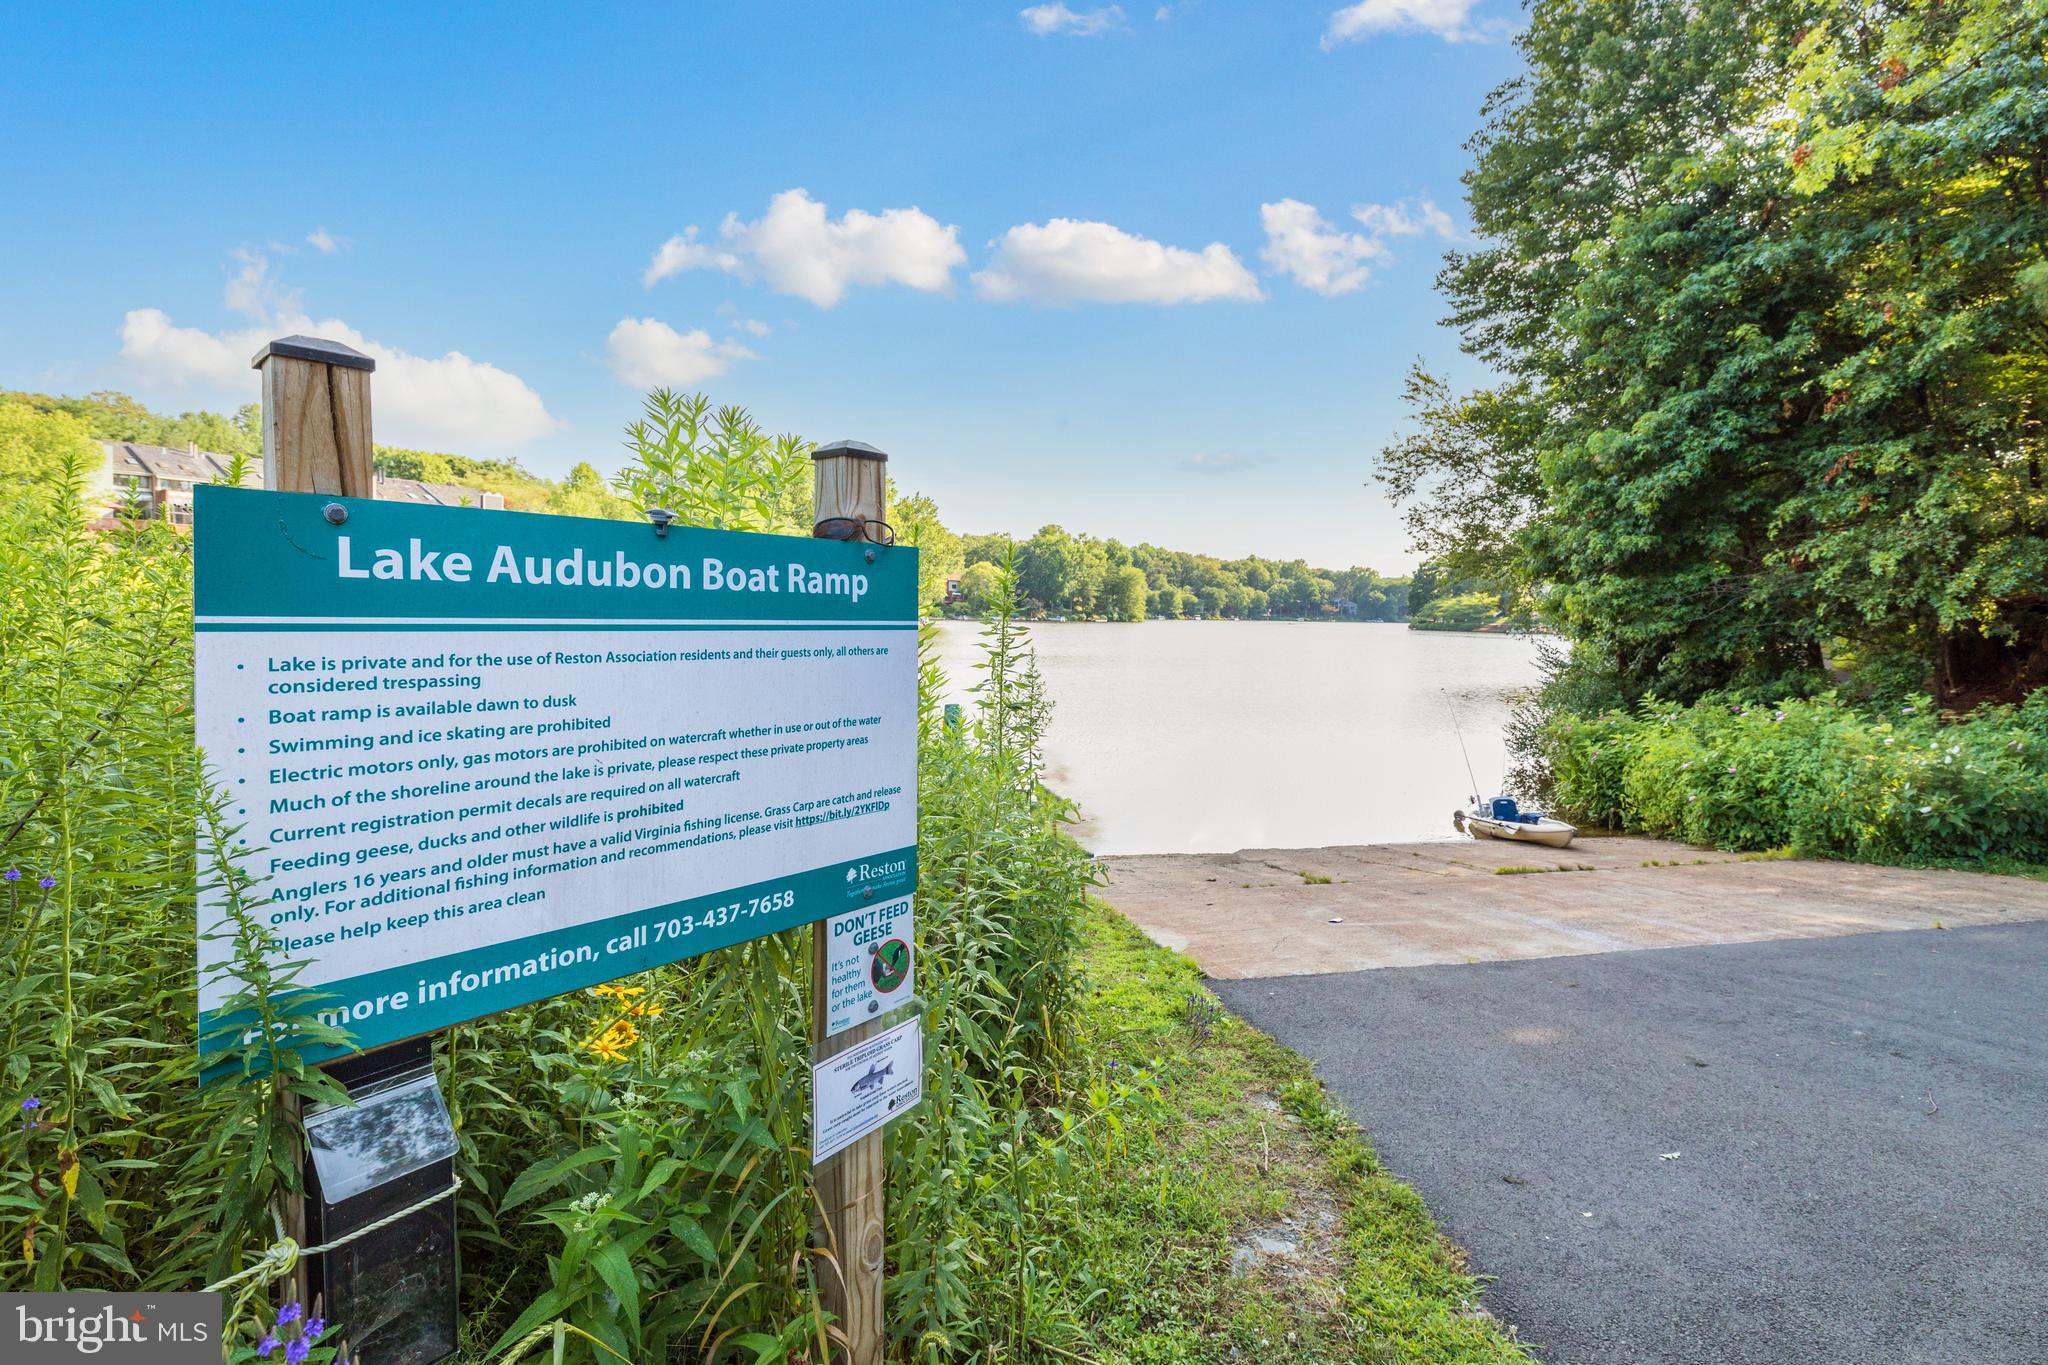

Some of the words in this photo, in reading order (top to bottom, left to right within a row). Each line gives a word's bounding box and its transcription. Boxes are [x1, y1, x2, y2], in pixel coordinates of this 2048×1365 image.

[338, 536, 472, 582] Lake
[486, 545, 690, 589] Audubon
[703, 558, 779, 592] Boat
[788, 563, 868, 602] Ramp
[268, 656, 316, 672] Lake
[321, 656, 336, 671] is
[341, 655, 407, 674] private
[411, 653, 444, 668] and
[448, 653, 472, 667] for
[476, 653, 502, 667] the
[506, 655, 533, 666] use
[536, 651, 552, 665] of
[555, 652, 602, 664] Reston
[605, 650, 677, 663] Association
[679, 649, 731, 661] residents
[732, 647, 753, 659] and
[754, 647, 779, 659] their
[780, 648, 812, 661] guests
[812, 646, 834, 659] only,
[836, 645, 847, 656] all
[847, 645, 875, 656] others
[875, 647, 889, 655] are
[268, 675, 378, 694] considered
[382, 673, 481, 692] trespassing
[269, 709, 316, 724] Boat
[321, 708, 372, 722] ramp
[376, 704, 390, 718] is
[395, 699, 472, 717] available
[476, 698, 519, 712] dawn
[523, 697, 539, 709] to
[542, 694, 576, 708] dusk
[269, 734, 374, 754] Swimming
[379, 729, 413, 746] and
[418, 729, 442, 742] ice
[446, 724, 505, 741] skating
[509, 724, 533, 735] are
[537, 715, 610, 736] prohibited
[270, 764, 343, 784] Electric
[348, 760, 413, 777] motors
[417, 753, 458, 771] only,
[462, 753, 491, 769] gas
[495, 748, 548, 762] motors
[551, 746, 574, 757] are
[577, 735, 647, 757] prohibited
[649, 737, 666, 747] on
[668, 728, 726, 745] watercraft
[728, 725, 772, 739] whether
[773, 724, 783, 735] in
[785, 724, 802, 733] use
[803, 723, 814, 732] or
[814, 720, 830, 731] out
[831, 717, 842, 729] of
[842, 717, 857, 728] the
[858, 716, 881, 726] water
[269, 794, 326, 814] Much
[331, 790, 352, 807] of
[355, 789, 386, 804] the
[391, 780, 470, 800] shoreline
[474, 771, 530, 790] around
[534, 769, 558, 783] the
[562, 766, 590, 780] lake
[593, 764, 604, 776] is
[607, 760, 654, 778] private,
[658, 756, 696, 772] please
[698, 750, 739, 765] respect
[740, 747, 768, 759] these
[770, 743, 804, 758] private
[805, 738, 845, 753] property
[846, 736, 869, 746] areas
[270, 821, 346, 843] Current
[351, 809, 454, 834] registration
[459, 800, 512, 822] permit
[515, 793, 562, 811] decals
[565, 792, 587, 804] are
[590, 781, 645, 801] required
[648, 782, 664, 793] on
[667, 777, 681, 790] all
[683, 769, 740, 788] watercraft
[270, 850, 350, 873] Feeding
[355, 842, 413, 864] geese,
[417, 832, 467, 851] ducks
[471, 825, 501, 843] and
[505, 821, 546, 837] other
[549, 812, 600, 830] wildlife
[603, 810, 613, 822] is
[616, 798, 684, 823] prohibited
[271, 879, 347, 901] Anglers
[353, 872, 375, 888] 16
[379, 867, 426, 888] years
[430, 857, 462, 875] and
[466, 852, 508, 869] older
[512, 845, 549, 862] must
[552, 840, 586, 854] have
[589, 838, 597, 848] a
[600, 829, 632, 846] valid
[634, 822, 681, 840] Virginia
[683, 817, 722, 832] fishing
[724, 811, 762, 825] license.
[764, 805, 791, 817] Grass
[792, 801, 814, 812] Carp
[815, 798, 831, 808] are
[831, 792, 855, 805] catch
[855, 789, 872, 801] and
[873, 786, 902, 797] release
[270, 905, 319, 924] only.
[324, 899, 355, 915] For
[360, 878, 450, 908] additional
[454, 871, 508, 890] fishing
[513, 856, 597, 880] information
[600, 847, 625, 864] and
[628, 831, 737, 858] recommendations,
[738, 823, 772, 840] please
[773, 818, 793, 831] visit
[859, 860, 906, 881] Reston
[271, 937, 335, 954] Please
[340, 921, 382, 940] help
[386, 913, 429, 931] keep
[433, 904, 464, 921] this
[468, 898, 502, 914] area
[506, 889, 545, 906] clean
[834, 911, 877, 937] DON'T
[880, 901, 909, 922] FEED
[853, 922, 892, 946] GEESE
[243, 1018, 302, 1046] Fo
[317, 991, 409, 1027] more
[418, 945, 599, 1004] information,
[606, 925, 646, 954] call
[653, 890, 794, 942] 703-437-7658
[831, 960, 844, 972] It's
[845, 955, 860, 966] not
[831, 968, 862, 986] healthy
[831, 988, 844, 1000] for
[844, 980, 866, 994] them
[831, 1003, 841, 1013] or
[842, 997, 856, 1009] the
[857, 990, 873, 1002] lake
[896, 1088, 917, 1104] Reston
